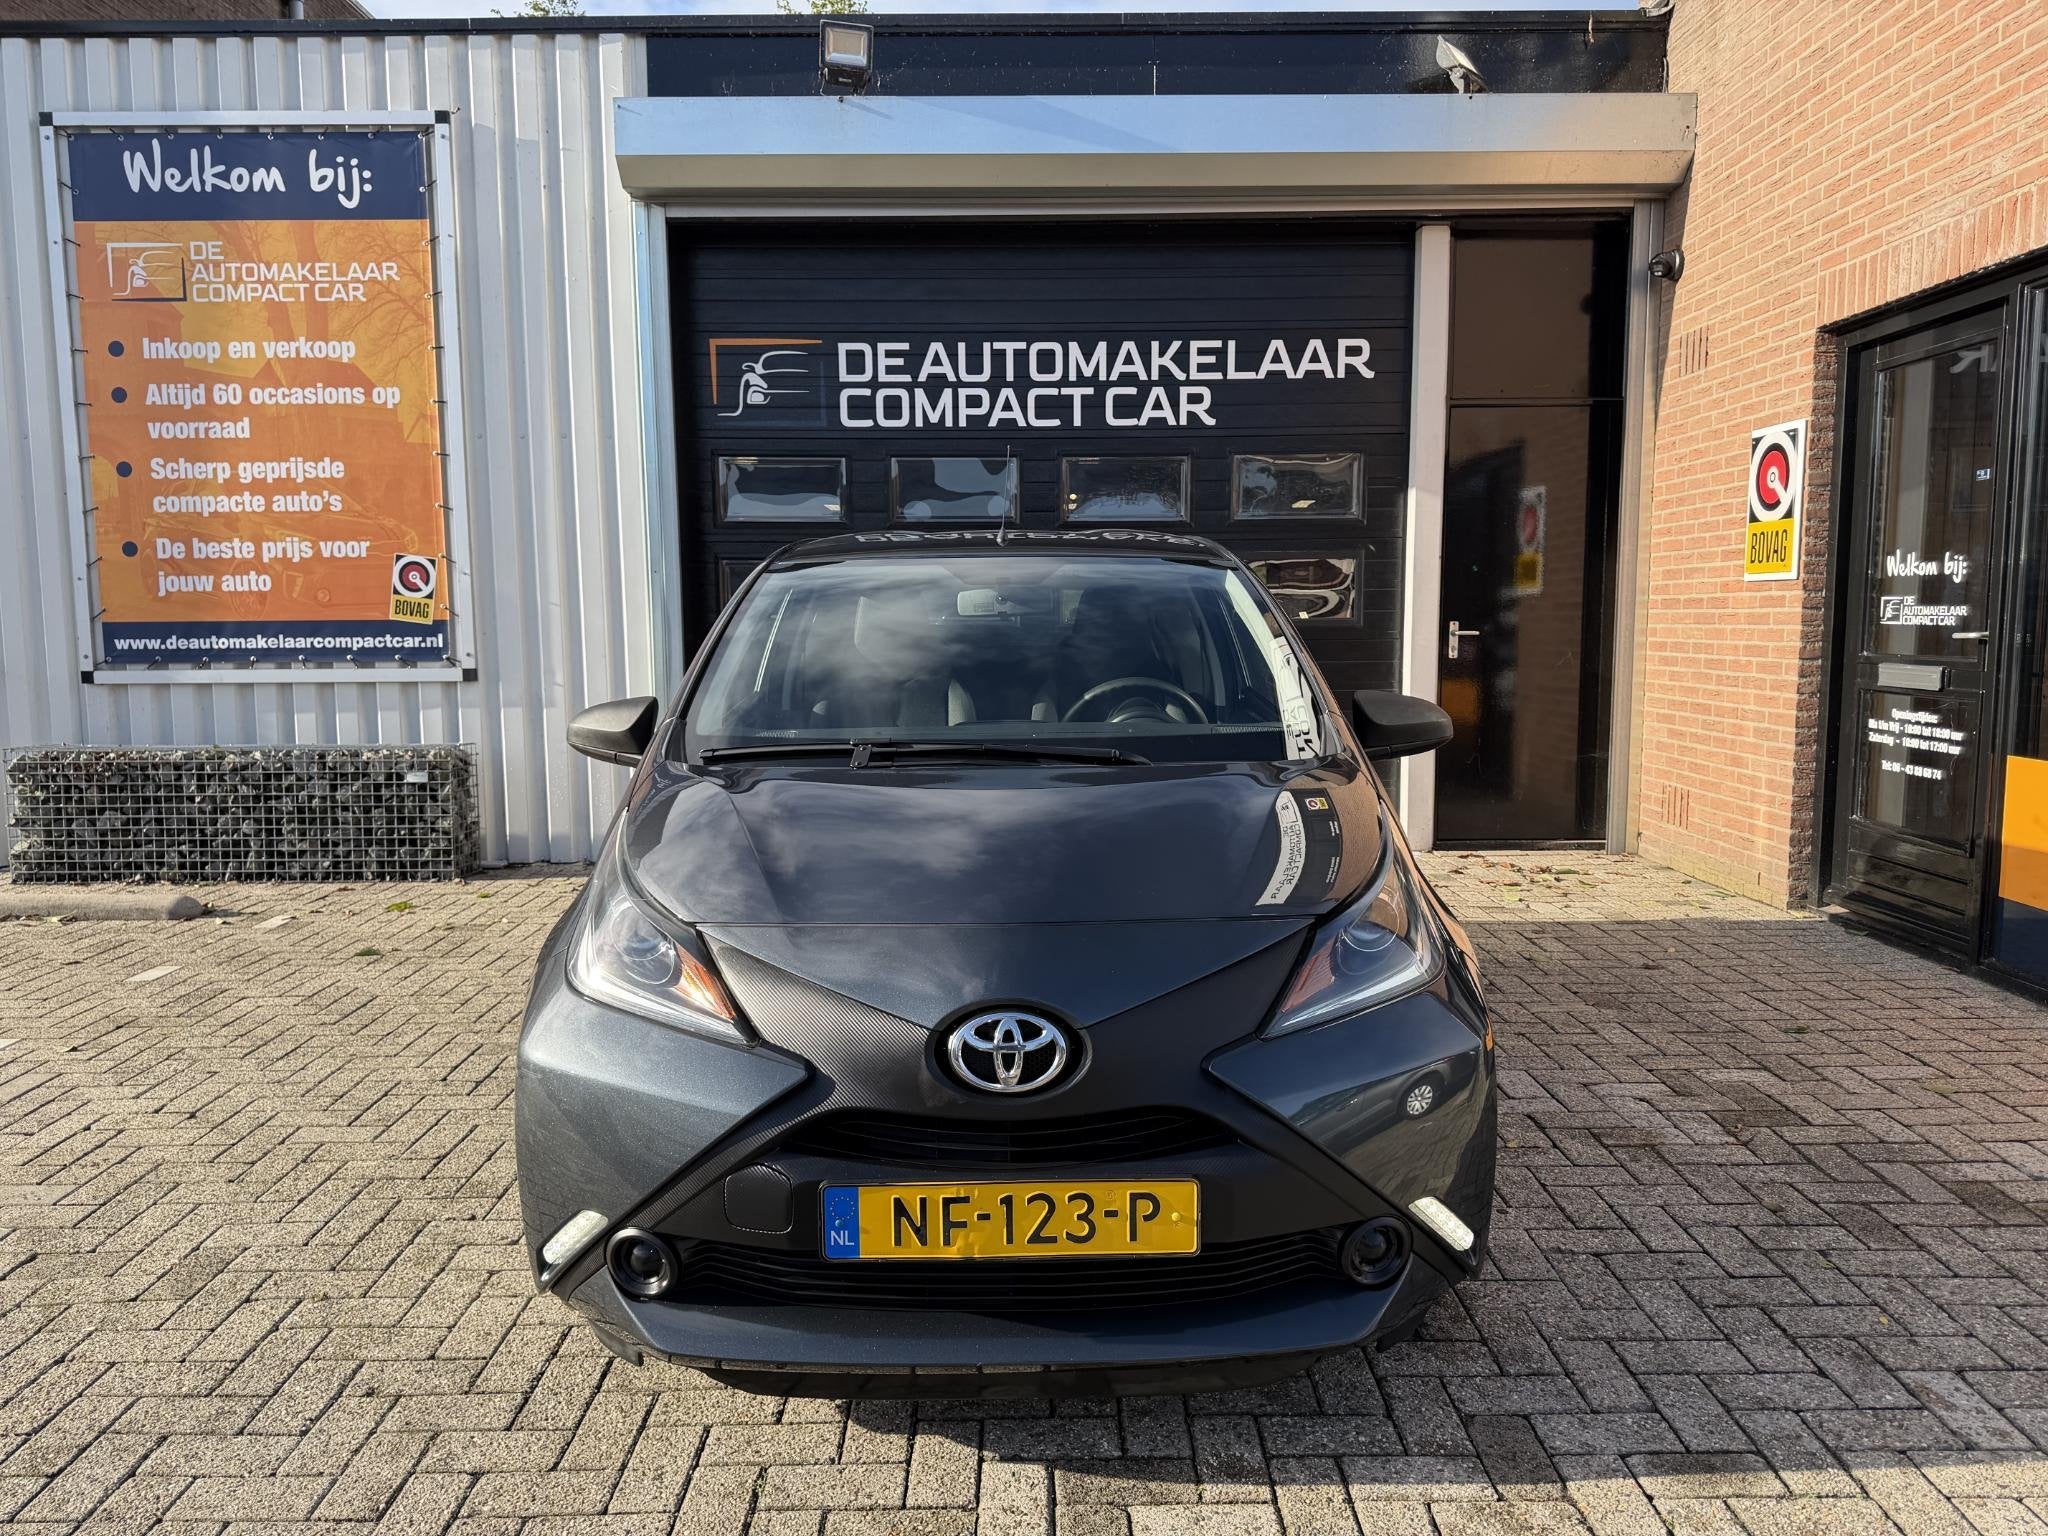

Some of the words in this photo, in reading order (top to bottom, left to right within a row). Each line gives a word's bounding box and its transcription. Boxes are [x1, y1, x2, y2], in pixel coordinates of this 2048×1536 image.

[123, 138, 286, 193] Welkom
[308, 148, 373, 209] bij:
[190, 241, 224, 260] DE
[192, 262, 401, 282] AUTOMAKELAAR
[192, 283, 310, 303] COMPACT
[314, 283, 367, 302] CAR
[142, 337, 221, 364] Inkoop
[227, 341, 257, 359] en
[262, 336, 356, 363] verkoop
[838, 342, 912, 382] DE
[917, 339, 1375, 382] AUTOMAKELAAR
[145, 383, 206, 410] Altijd
[213, 383, 243, 405] 60
[249, 382, 366, 405] occasions
[372, 386, 401, 409] op
[839, 387, 1095, 428] COMPACT
[1105, 385, 1216, 427] CAR
[147, 416, 251, 440] voorraad
[150, 457, 232, 484] Scherp
[237, 456, 345, 484] geprijsde
[152, 493, 266, 517] compacte
[271, 489, 343, 512] auto's
[156, 538, 186, 559] De
[192, 537, 255, 559] beste
[261, 536, 314, 563] prijs
[319, 540, 370, 558] voor
[1750, 528, 1788, 564] BOVAG
[1887, 549, 1938, 577] Welkom
[1943, 551, 1968, 584] bij:
[158, 571, 214, 597] jouw
[221, 570, 272, 592] auto
[394, 599, 430, 619] BOVAG
[1903, 596, 1916, 606] DE
[1903, 605, 1968, 616] AUTOMAKELAAR
[1903, 615, 1938, 625] COMPACT
[1938, 616, 1956, 626] CAR
[114, 633, 444, 651] www.deautomakelaarcompactcar.nl
[893, 1192, 1161, 1247] NF-123-P
[830, 1230, 855, 1246] NL
